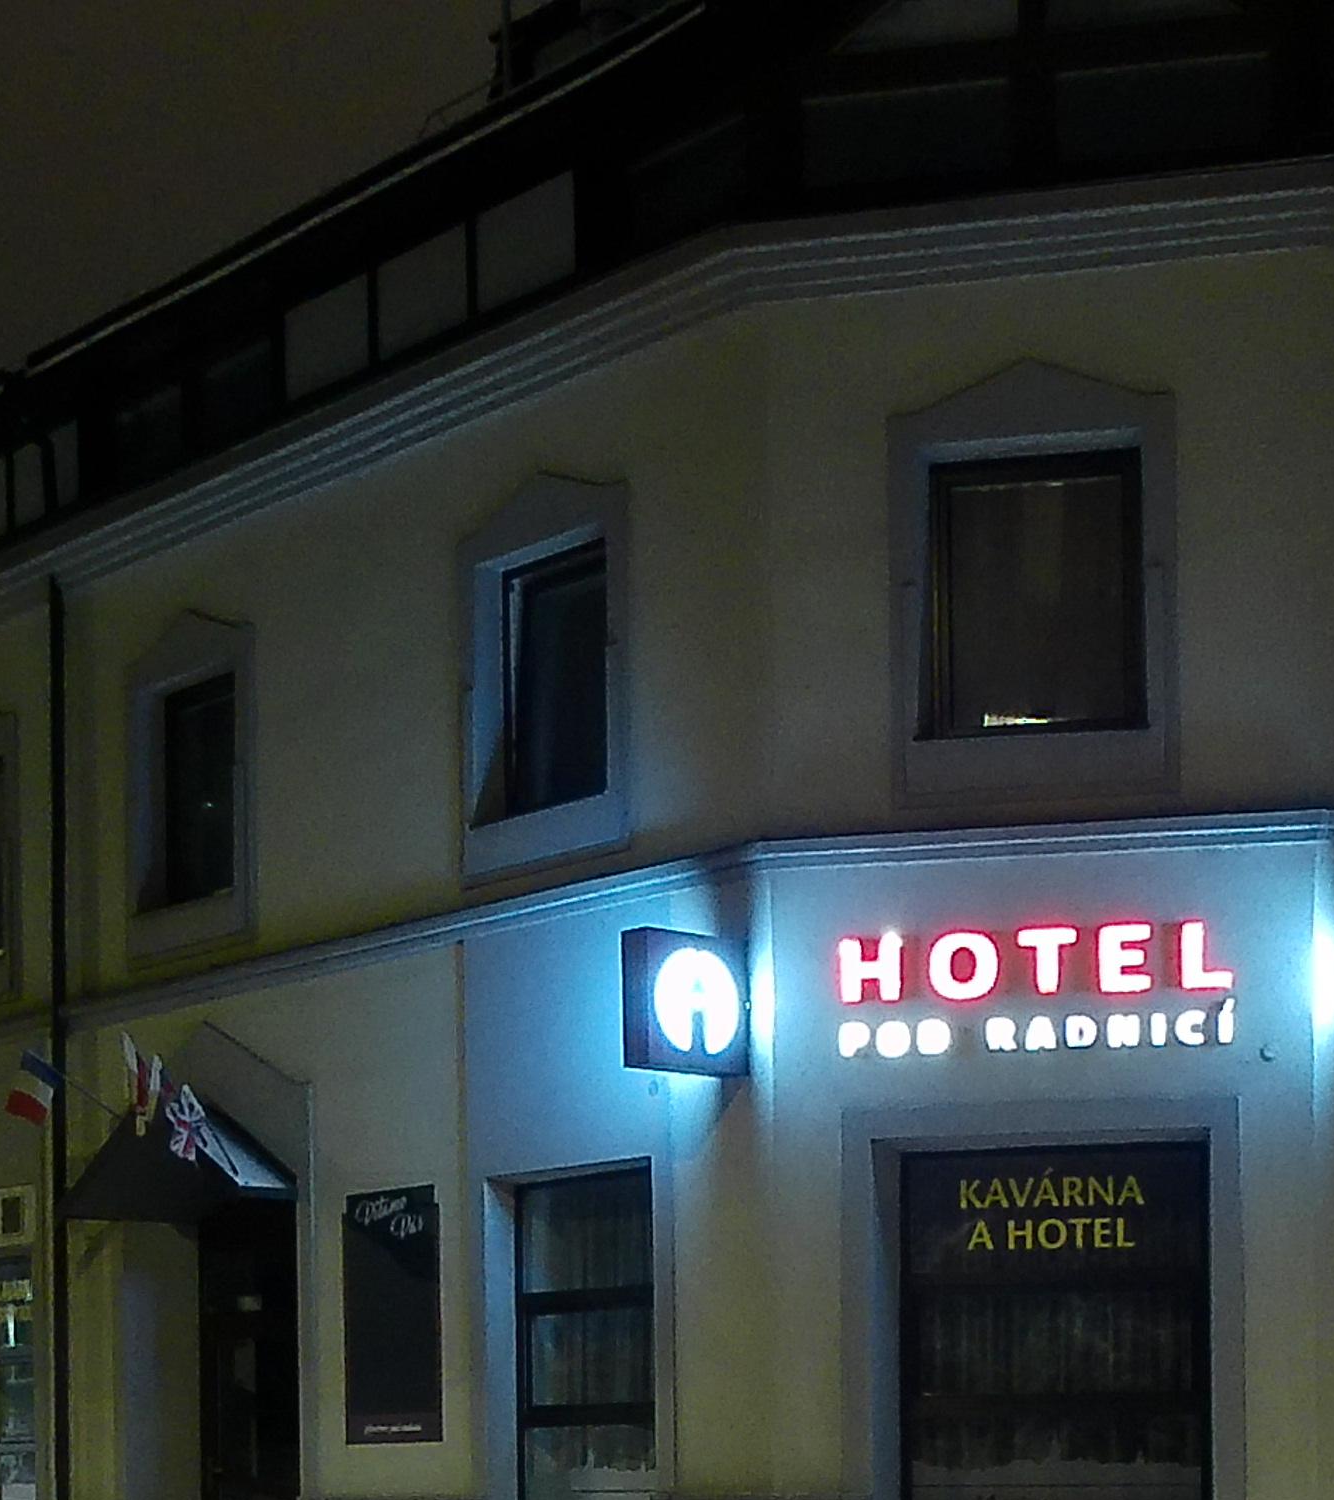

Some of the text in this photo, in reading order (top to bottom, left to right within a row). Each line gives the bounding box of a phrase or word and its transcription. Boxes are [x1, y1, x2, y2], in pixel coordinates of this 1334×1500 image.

[837, 920, 1235, 1003] HOTEL
[837, 1018, 951, 1058] POD
[984, 998, 1235, 1051] RADNICÍ
[958, 1166, 1146, 1209] KAVÁRNA
[966, 1217, 1137, 1251] A HOTEL
